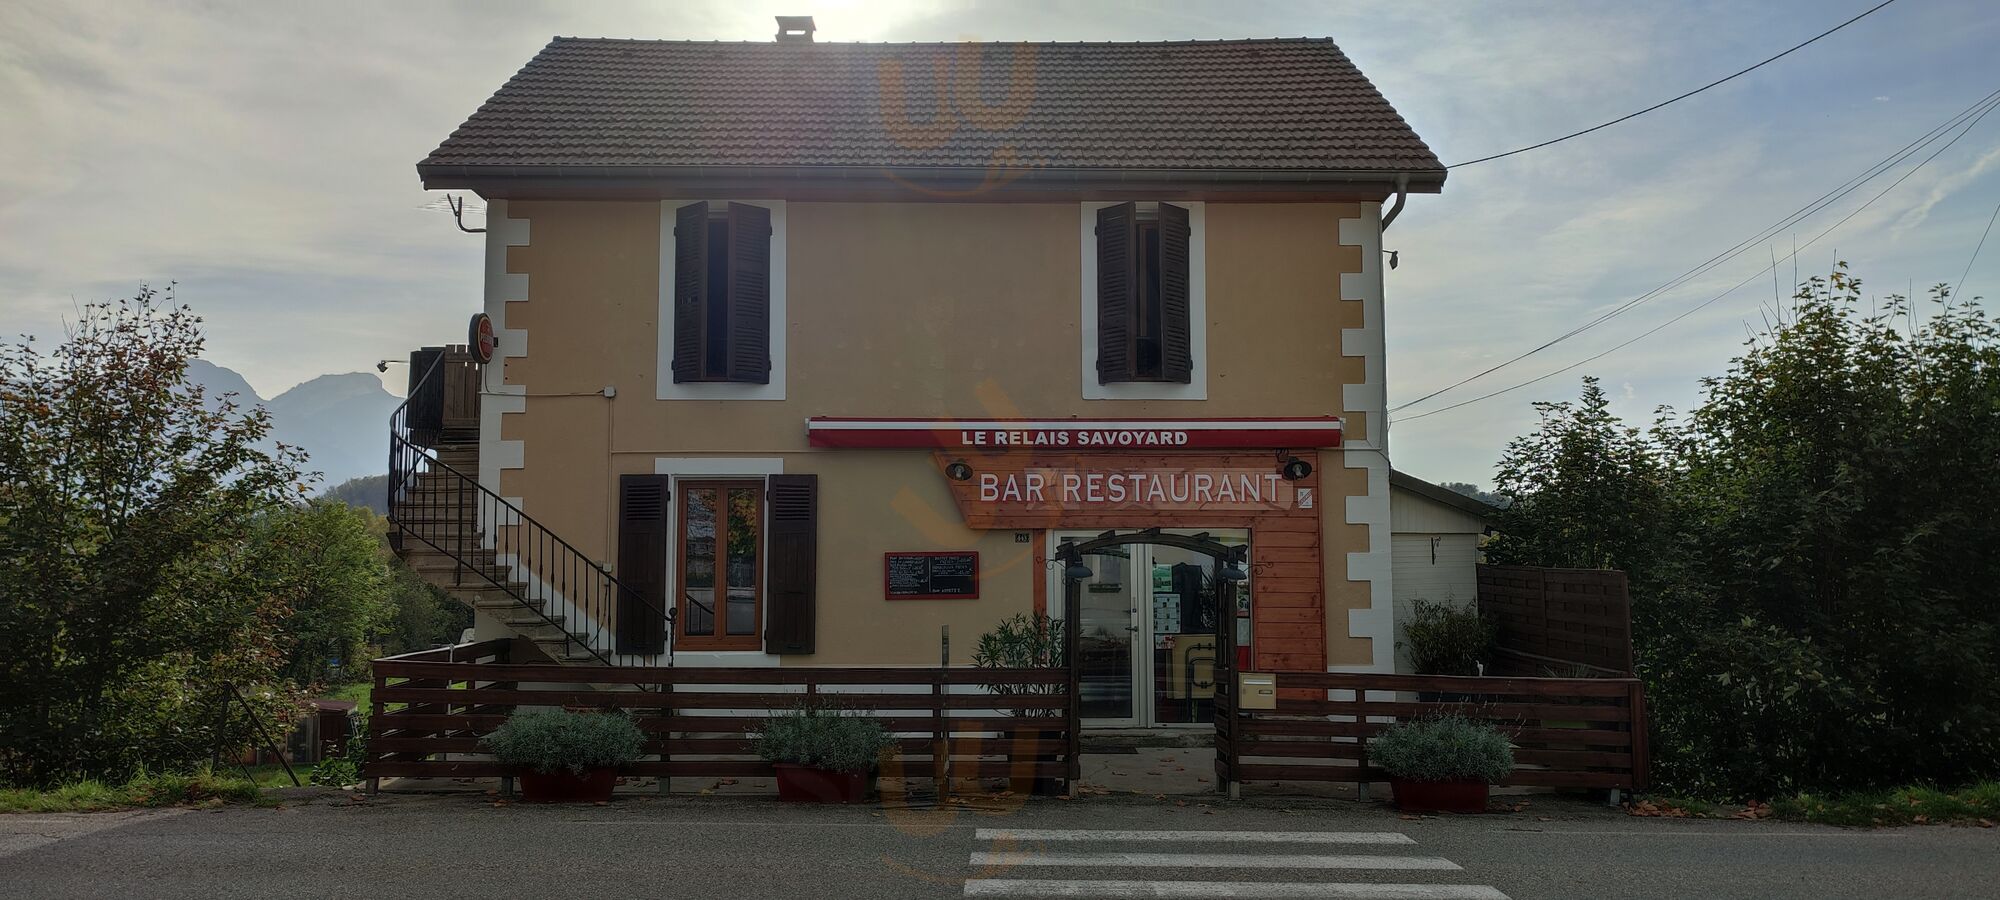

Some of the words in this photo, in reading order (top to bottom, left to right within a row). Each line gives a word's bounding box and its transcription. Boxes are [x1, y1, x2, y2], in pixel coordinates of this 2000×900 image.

[961, 431, 986, 445] LE
[994, 431, 1070, 445] RELAIS
[1077, 431, 1188, 446] SAVOYARD
[980, 473, 1046, 502] BAR
[1063, 473, 1283, 503] RESTAURANT
